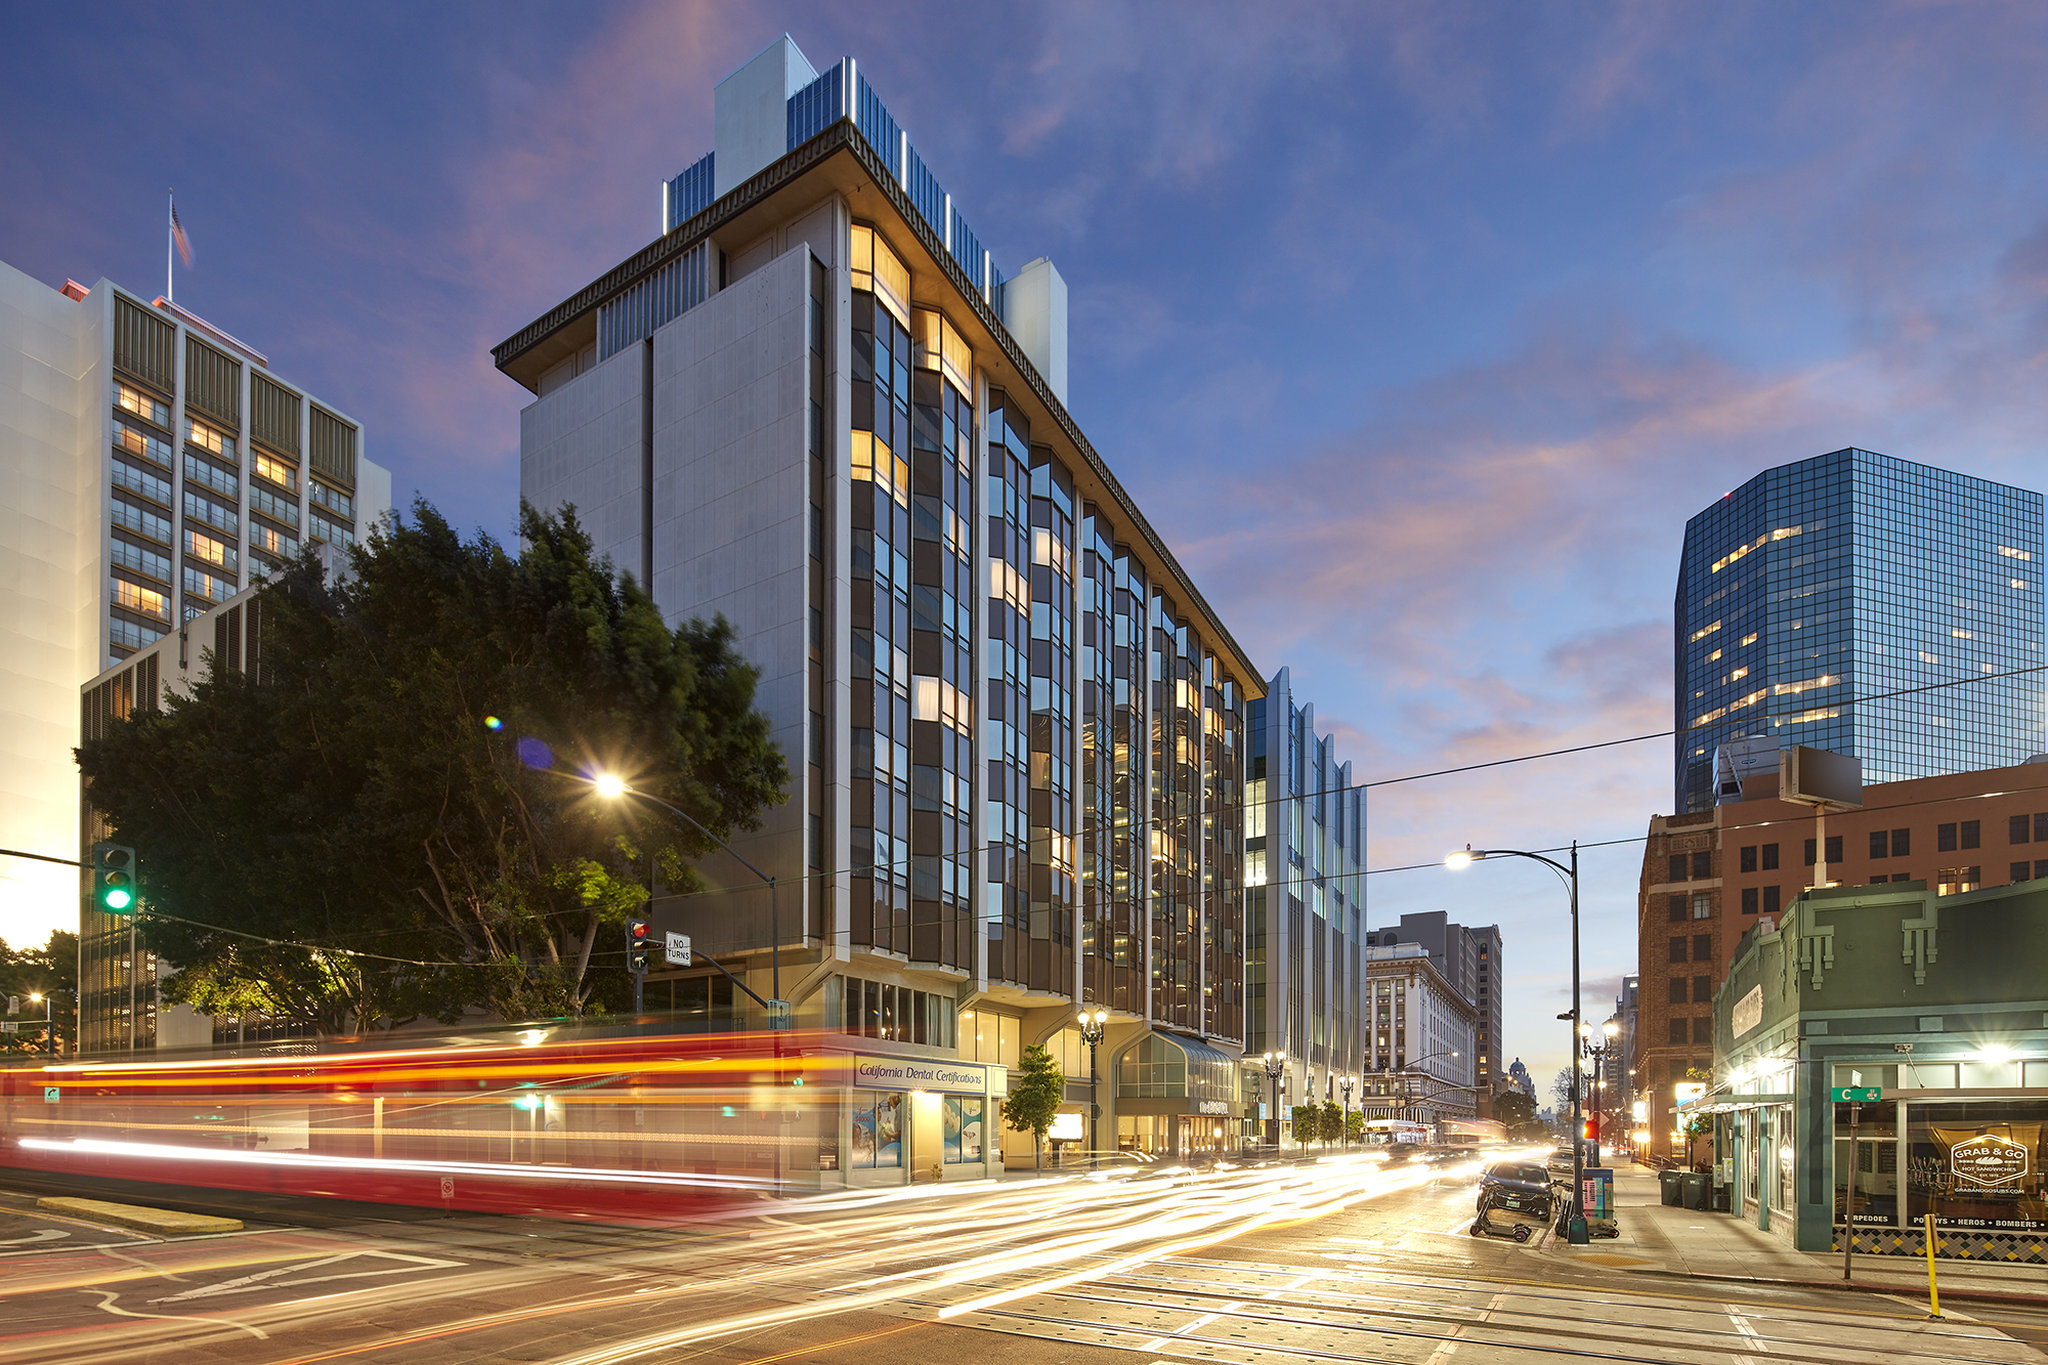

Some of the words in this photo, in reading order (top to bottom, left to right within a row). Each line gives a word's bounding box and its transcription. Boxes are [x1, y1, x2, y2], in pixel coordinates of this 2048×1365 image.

[674, 939, 684, 948] NO
[668, 949, 689, 960] TURNS
[859, 1063, 903, 1079] California
[906, 1066, 934, 1080] Dental
[936, 1069, 982, 1084] Certifications
[1841, 1089, 1852, 1100] C
[1955, 1147, 1990, 1158] GRAB
[1993, 1147, 2002, 1156] &
[2004, 1149, 2024, 1159] GO
[1844, 1214, 1889, 1222] TRPEDOES
[1957, 1218, 1986, 1226] HEROS
[1995, 1219, 2038, 1228] BOMBERS
